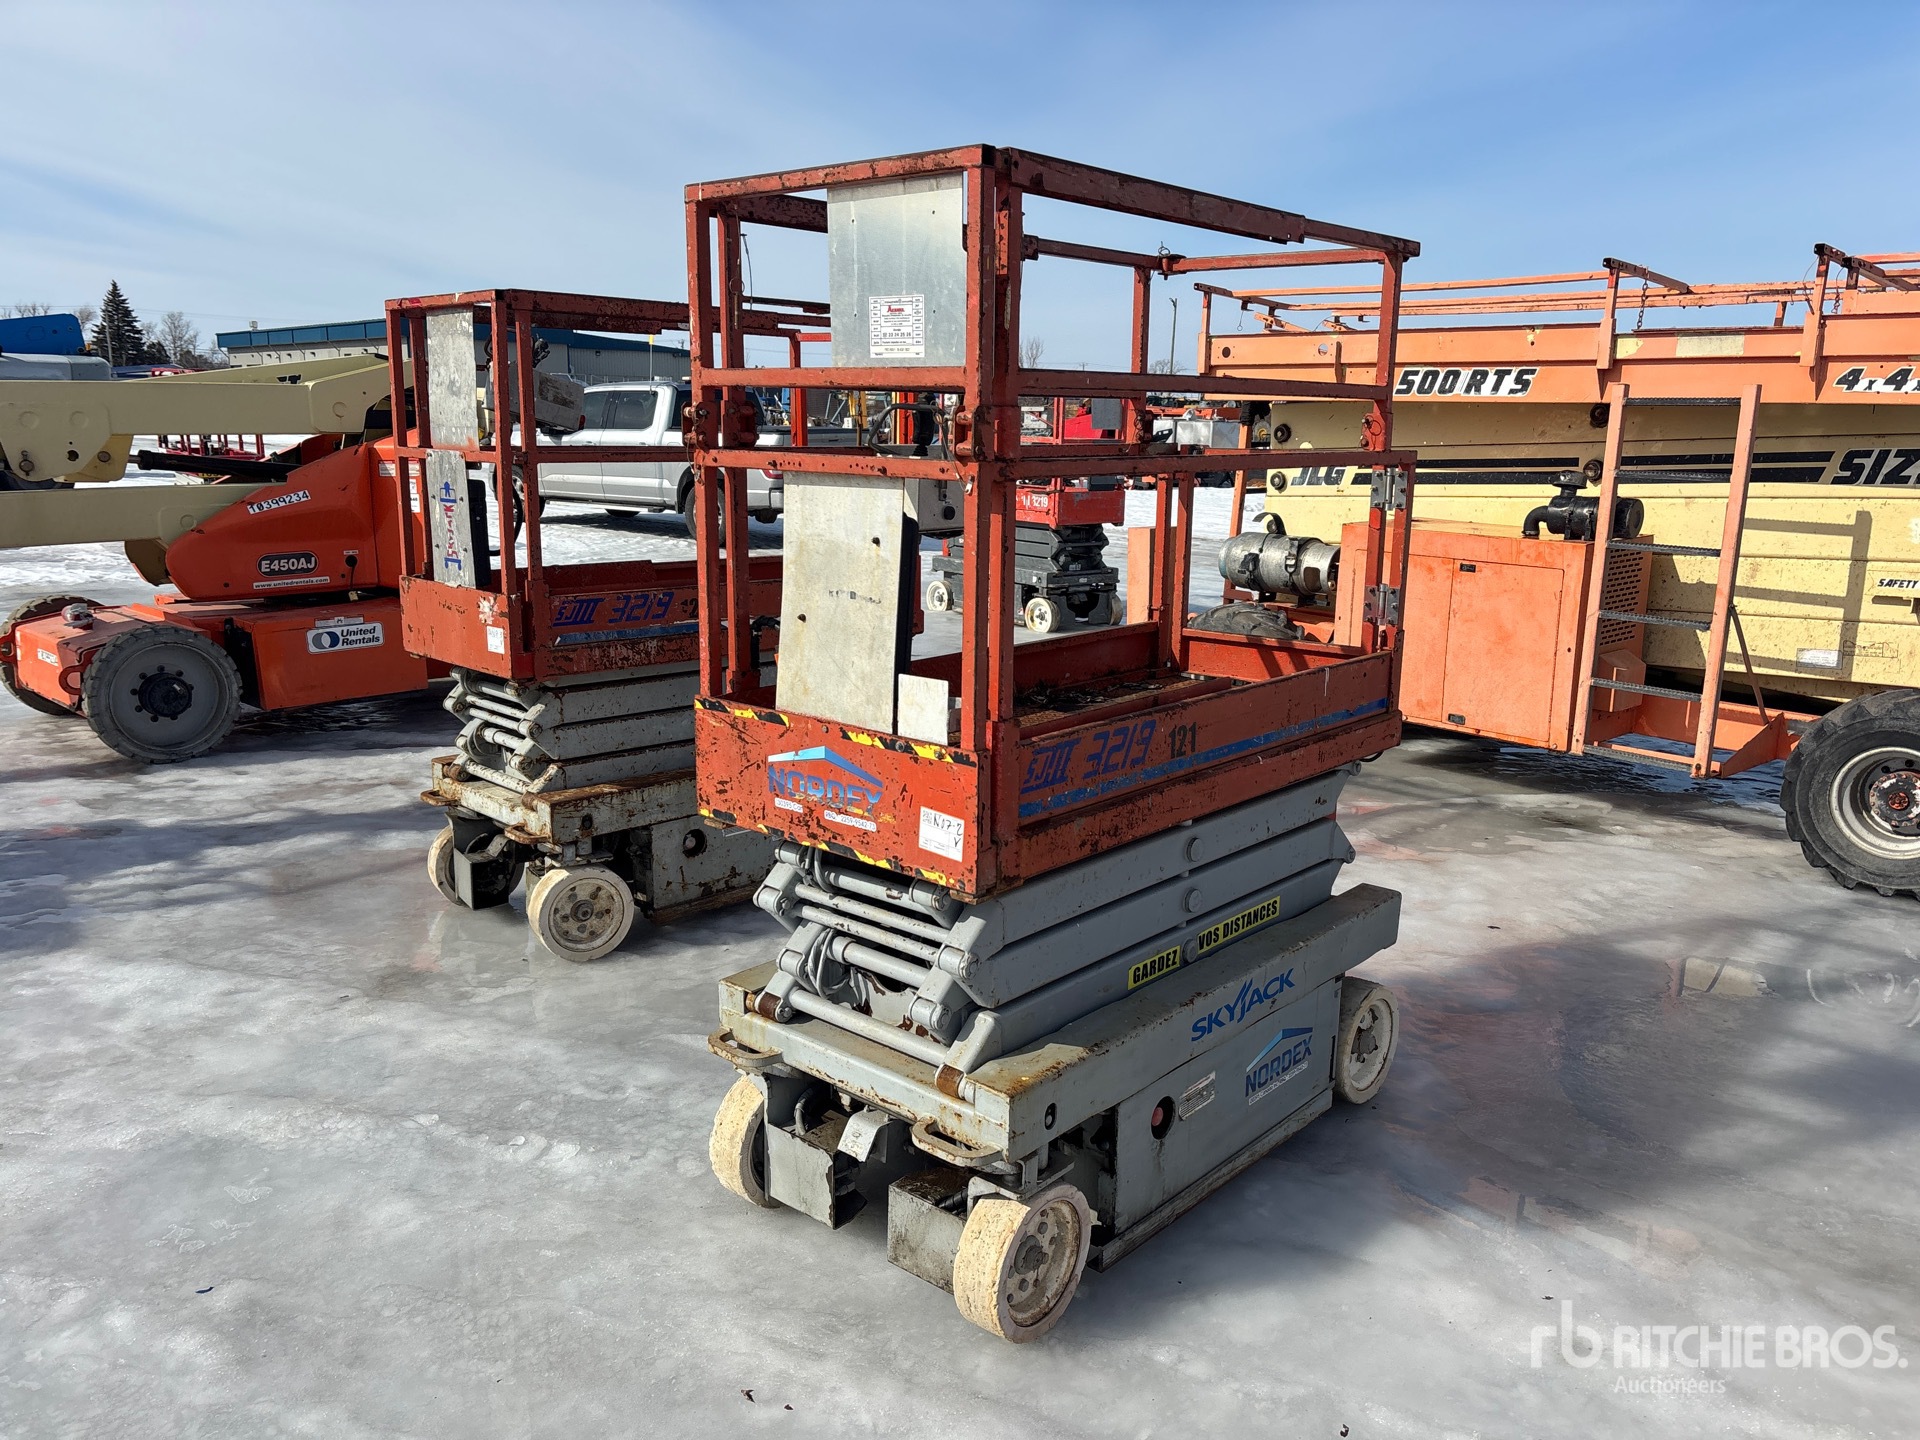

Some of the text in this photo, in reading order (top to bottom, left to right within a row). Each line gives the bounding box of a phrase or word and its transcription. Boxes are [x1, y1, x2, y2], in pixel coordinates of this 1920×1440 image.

[1830, 449, 1920, 485] SIZ
[249, 490, 310, 513] 10399234
[261, 557, 315, 573] E450AJ
[254, 578, 329, 589] www.unitedrentals.com
[1877, 578, 1919, 588] SAFETY
[608, 591, 674, 624] 3219
[341, 626, 376, 637] United
[341, 635, 380, 646] Rentals
[1082, 718, 1157, 780] 3219
[1168, 721, 1197, 760] 121
[1133, 899, 1278, 985] GARDEZ VOS DISTANCES
[1191, 967, 1295, 1042] SKYJACK
[1245, 1035, 1313, 1097] NORDEX
